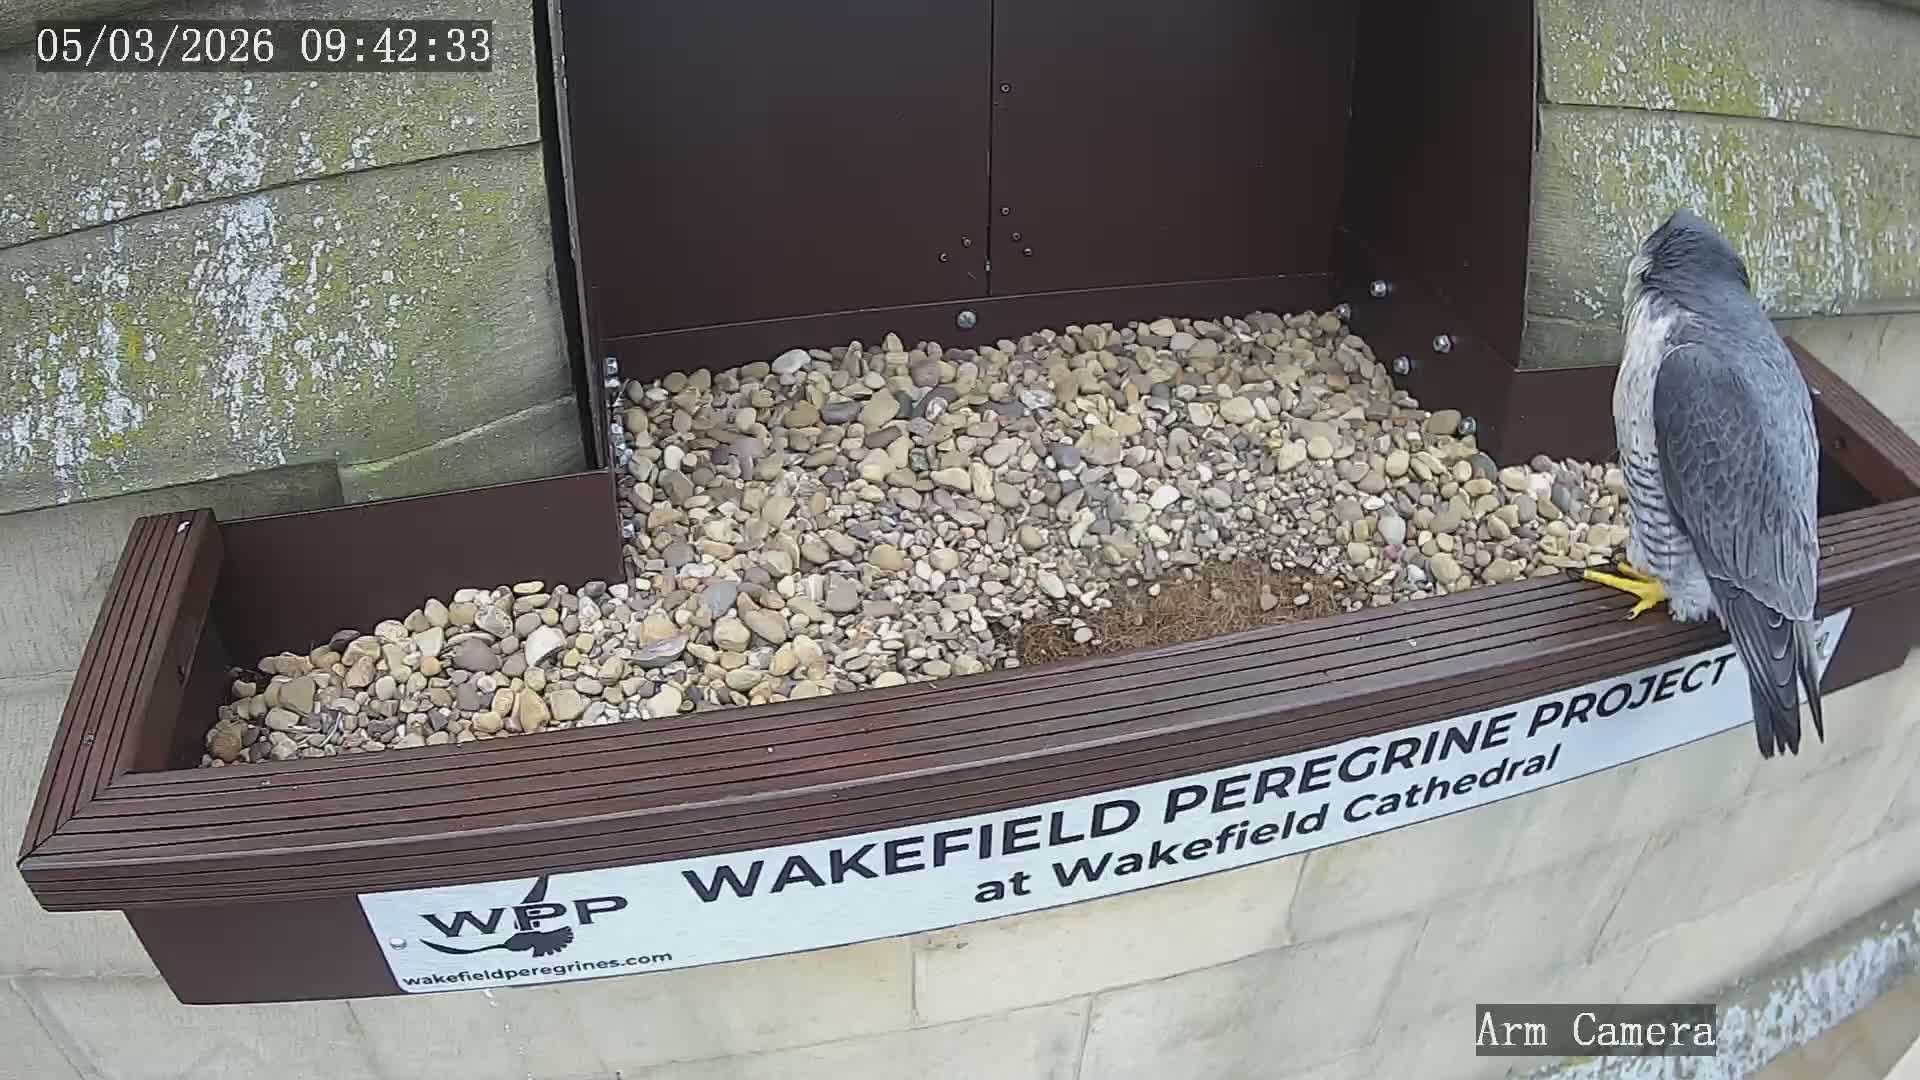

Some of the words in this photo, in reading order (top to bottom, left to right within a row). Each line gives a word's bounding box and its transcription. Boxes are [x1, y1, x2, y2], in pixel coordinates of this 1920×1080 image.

[682, 799, 1141, 903] WAKEFIELD
[1163, 711, 1518, 823] PEREGRINE
[1527, 652, 1737, 738] PROJECT
[974, 871, 1031, 903] at
[1053, 804, 1330, 888] Wakefield
[1344, 745, 1561, 822] Cathedral
[420, 895, 629, 938] WPP
[402, 951, 673, 987] wakefieldperegrines.com
